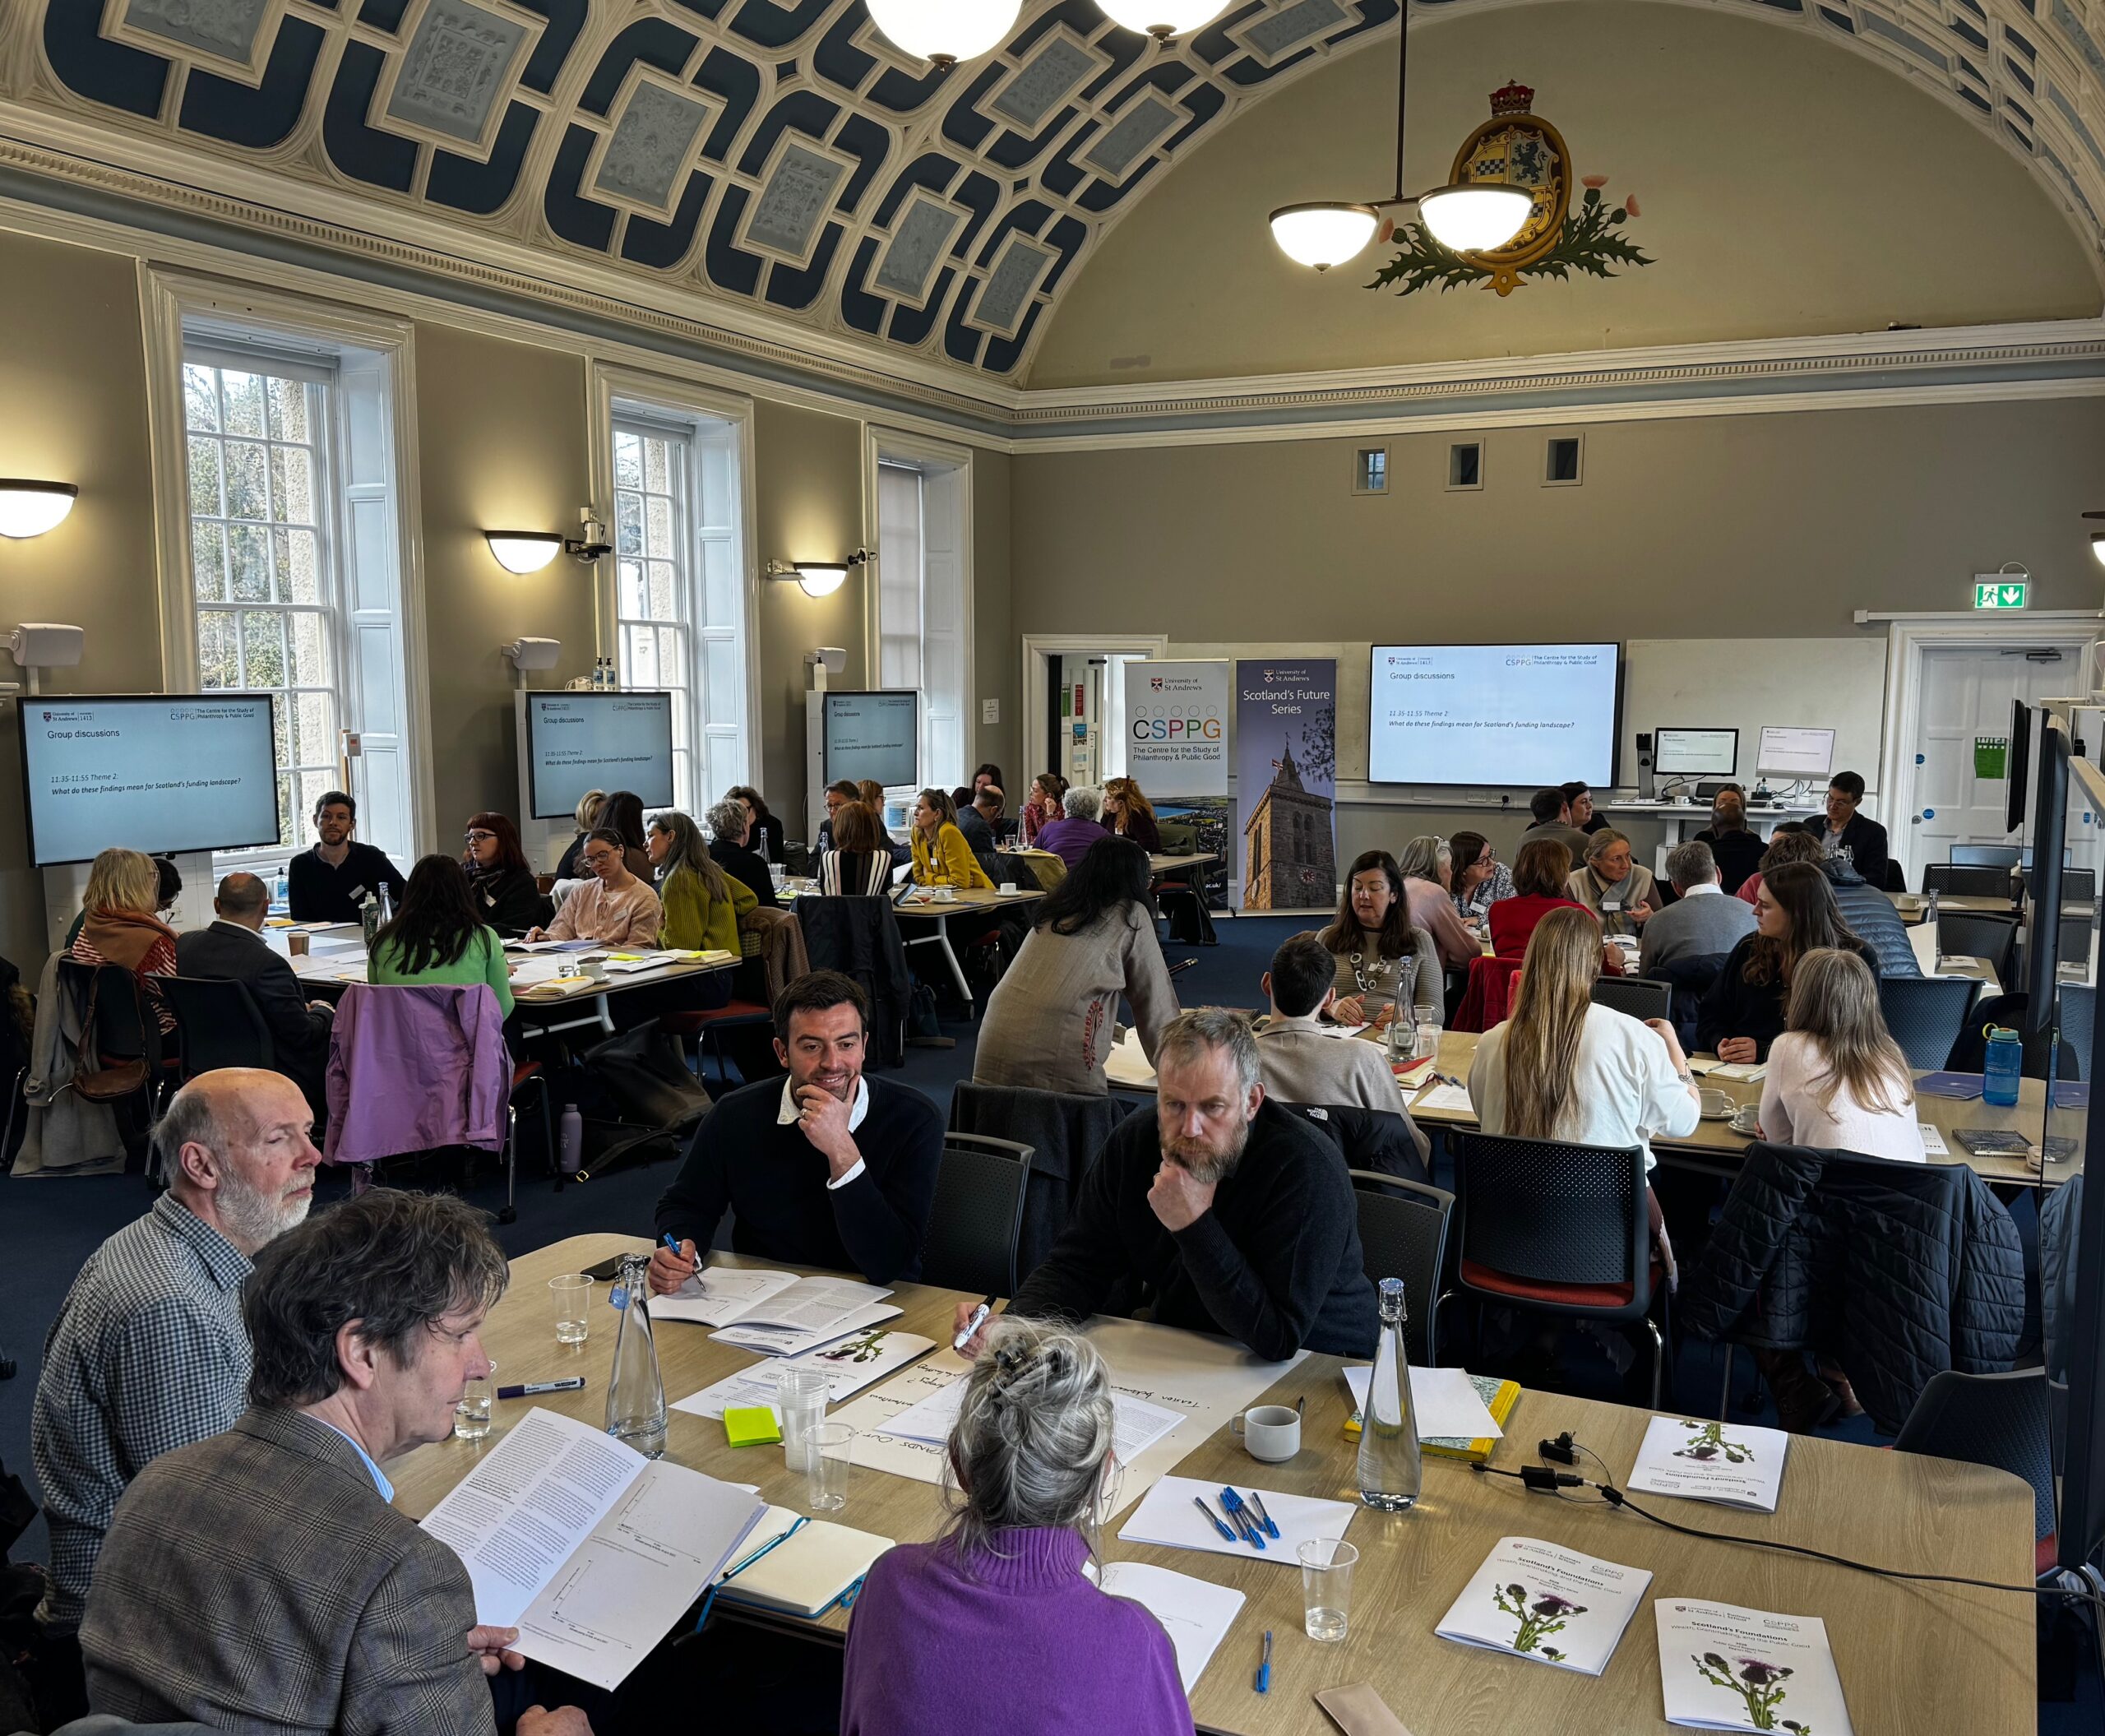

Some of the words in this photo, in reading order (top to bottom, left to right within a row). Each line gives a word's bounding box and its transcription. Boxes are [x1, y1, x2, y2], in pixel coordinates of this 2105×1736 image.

[1243, 690, 1294, 701] Scotland's
[1297, 690, 1330, 700] Future
[1271, 704, 1302, 715] Series
[47, 730, 73, 740] Group
[75, 729, 120, 738] discussions
[1133, 719, 1221, 739] CSPPG
[1192, 746, 1212, 755] Study
[51, 774, 89, 783] 11:35-11:55
[99, 785, 125, 794] findings
[145, 782, 153, 791] for
[155, 781, 185, 789] Scotland's
[186, 780, 208, 789] funding
[210, 778, 241, 786] landscape?
[1517, 1557, 1555, 1572] Scotland's
[1556, 1568, 1604, 1586] Foundations
[1691, 1621, 1734, 1632] Scotland's
[1735, 1628, 1788, 1642] Foundations
